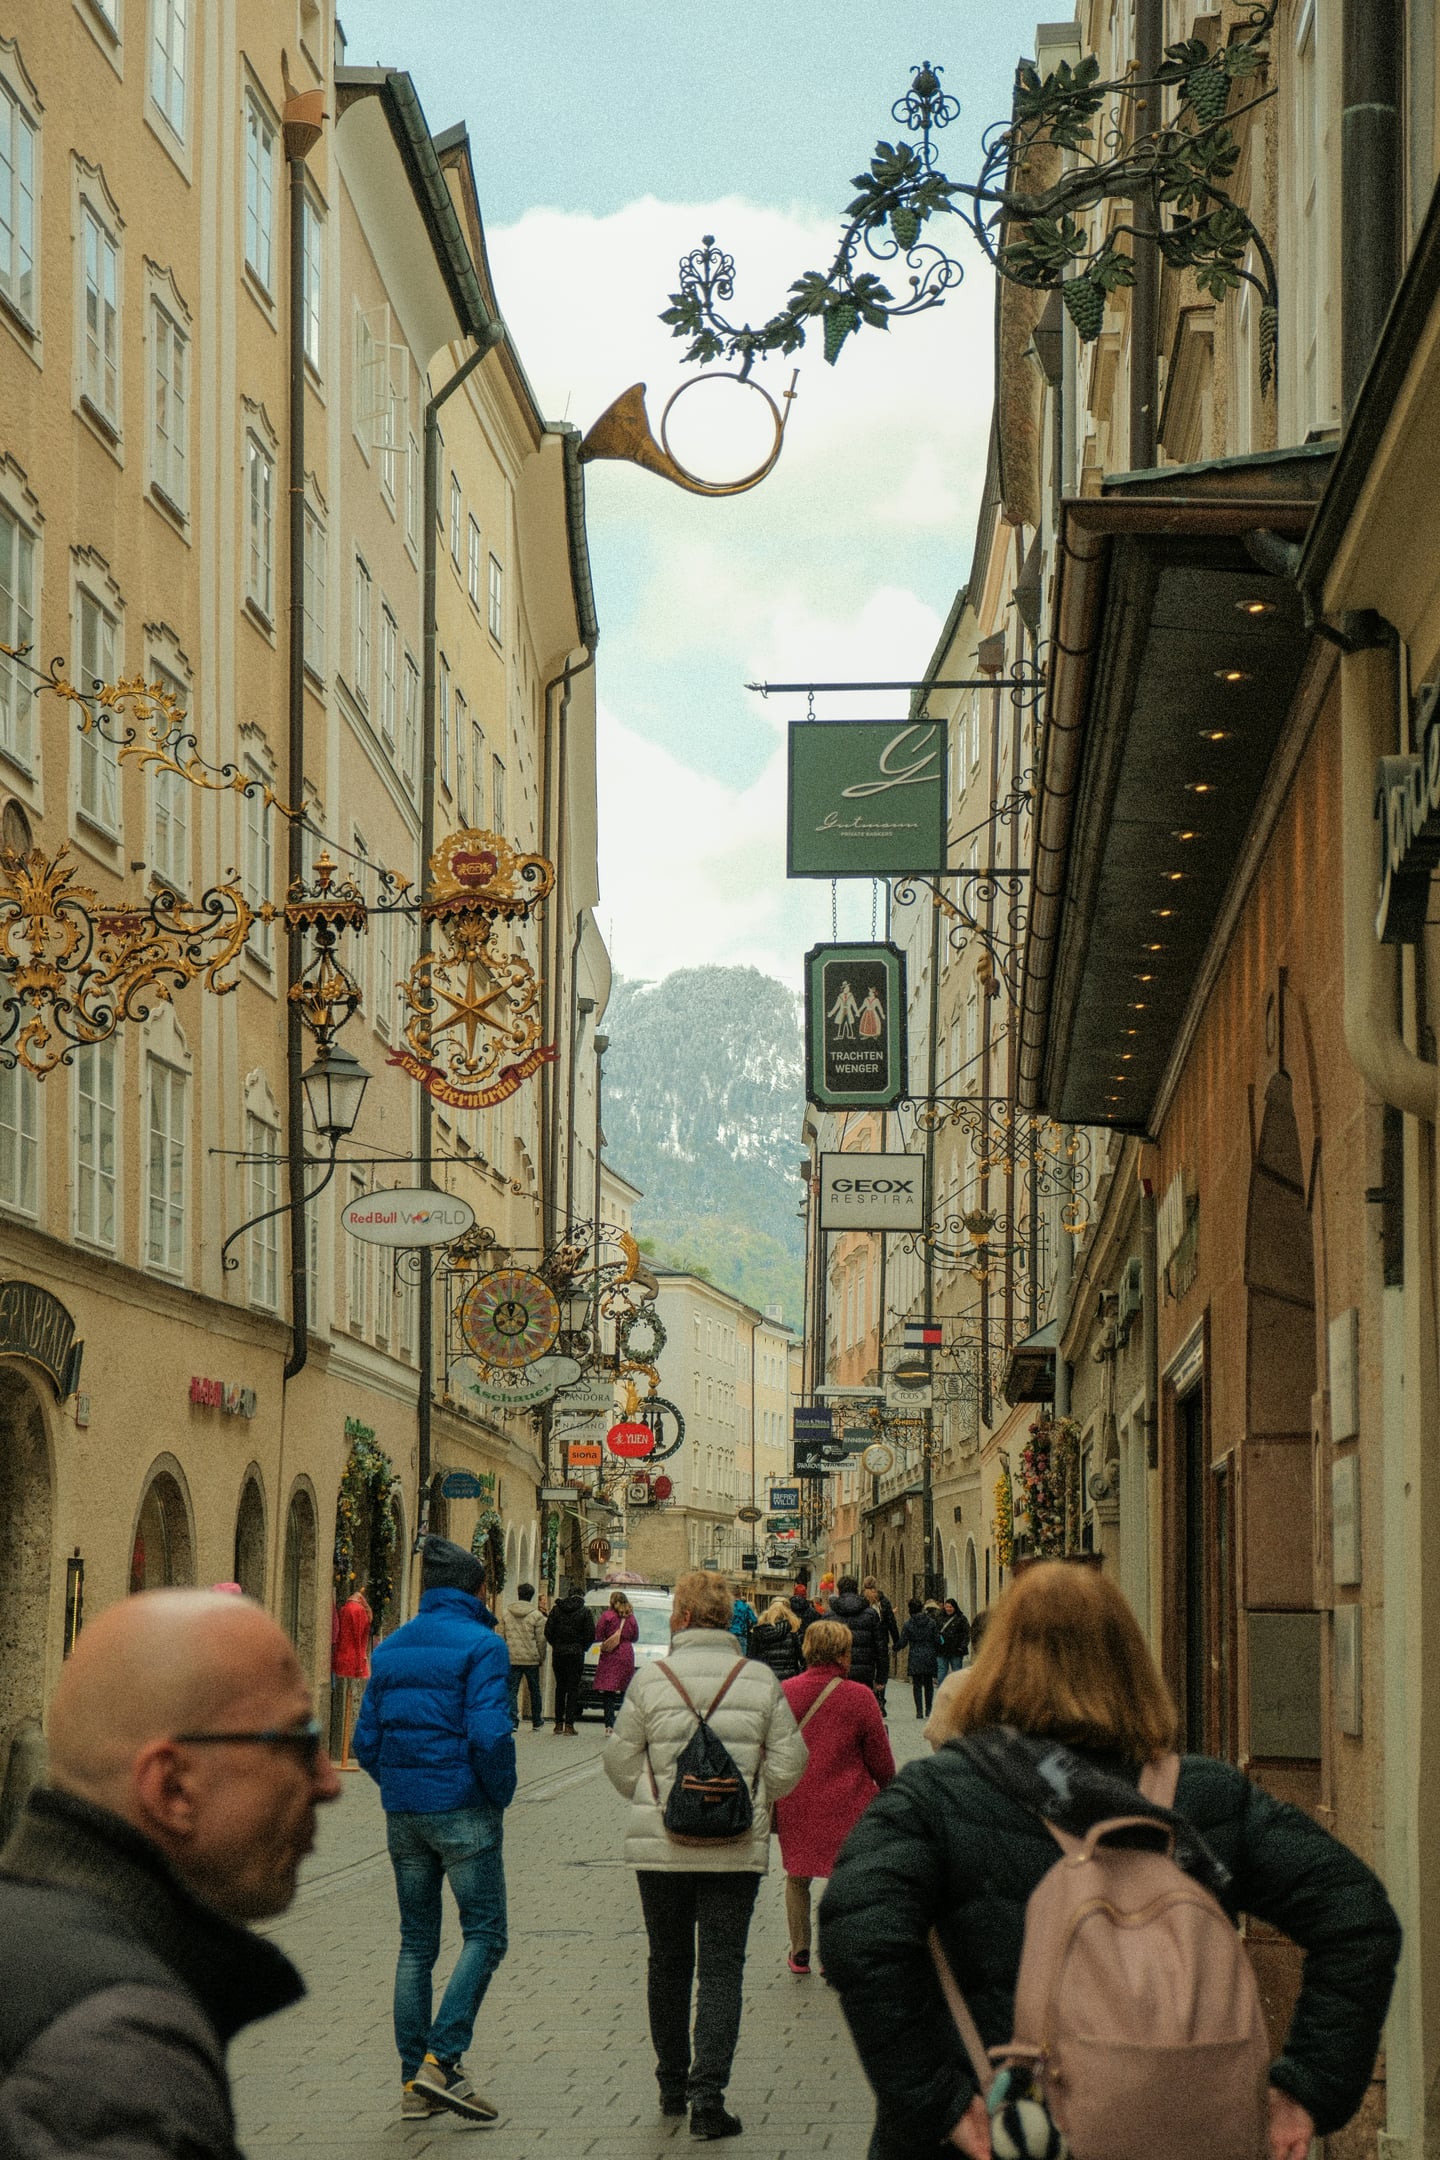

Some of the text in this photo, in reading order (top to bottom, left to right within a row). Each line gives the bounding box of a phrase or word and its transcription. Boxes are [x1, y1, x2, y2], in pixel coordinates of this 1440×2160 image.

[815, 811, 920, 832] Gutmann
[830, 1051, 884, 1061] TRACHTEN
[400, 1056, 427, 1081] 1720
[517, 1052, 546, 1077] 2014
[835, 1063, 879, 1073] WENGER
[429, 1077, 519, 1107] Sternbräu
[831, 1178, 914, 1194] GEOX
[831, 1194, 914, 1204] RESPIRA
[350, 1211, 373, 1224] Red
[374, 1211, 398, 1224] Bull
[467, 1382, 553, 1403] Aschauer
[563, 1392, 611, 1402] PANDORA
[562, 1421, 606, 1431] NAGANO
[625, 1433, 649, 1444] YUEN
[571, 1451, 598, 1459] siona
